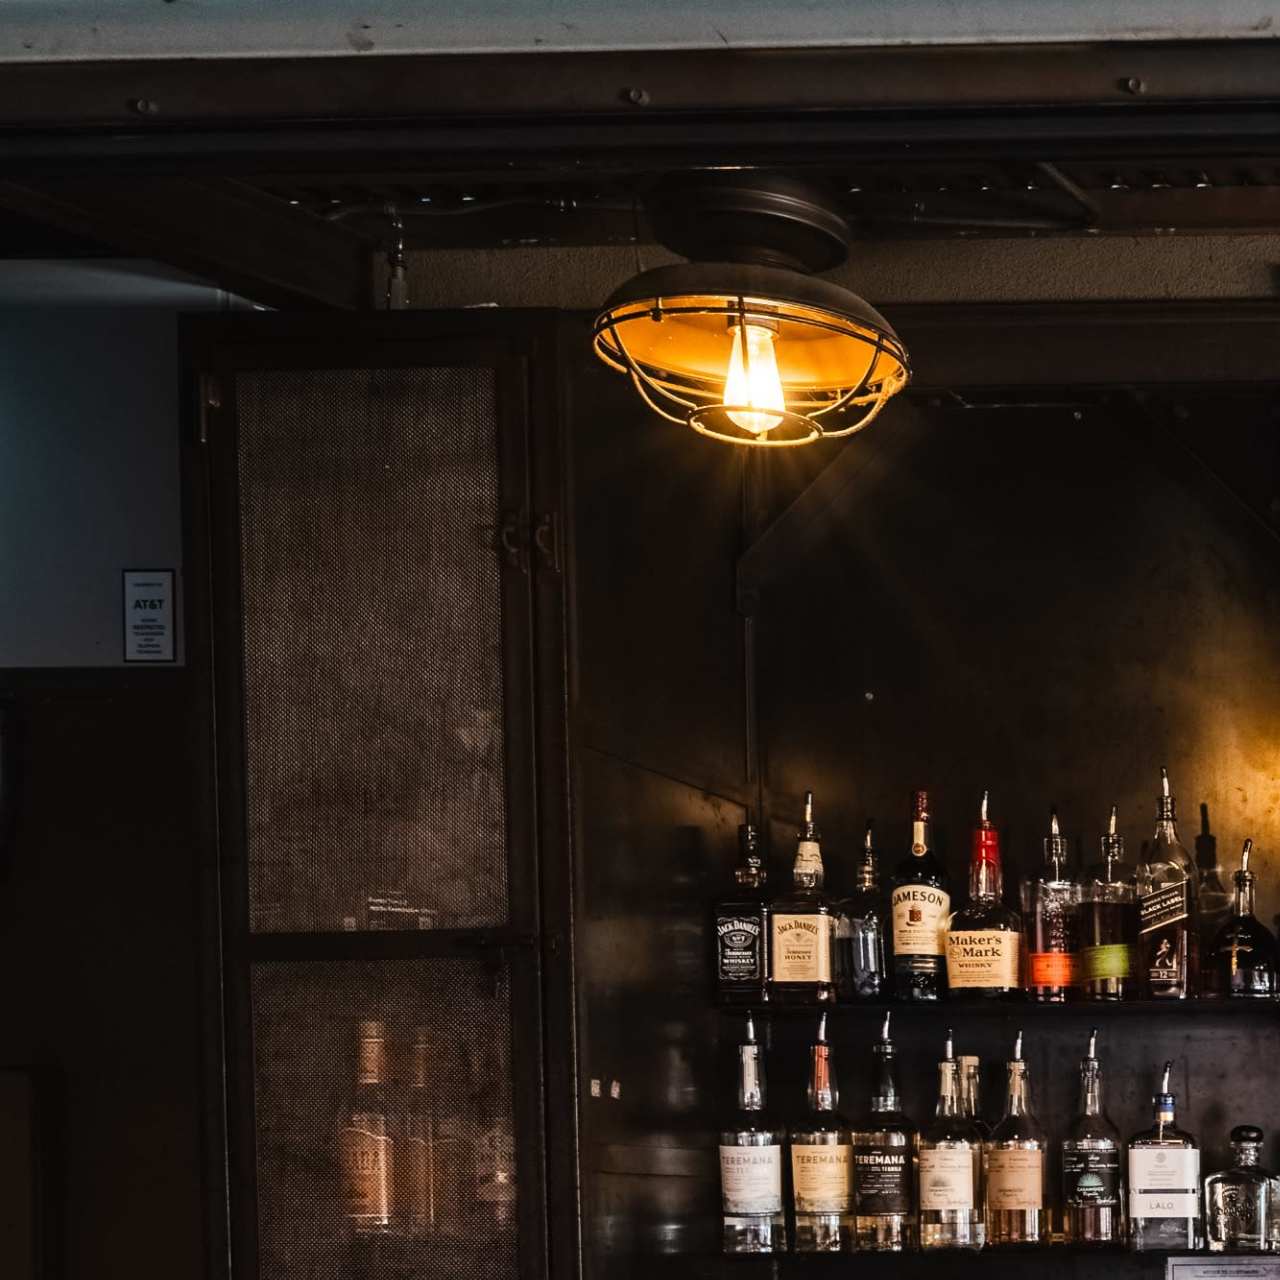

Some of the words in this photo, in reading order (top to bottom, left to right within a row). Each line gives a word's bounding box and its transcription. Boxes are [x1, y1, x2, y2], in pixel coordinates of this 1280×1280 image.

[134, 599, 163, 610] AT&T
[892, 890, 944, 907] JAMESON
[949, 935, 1002, 946] Maker's
[962, 947, 1001, 958] Mark
[722, 1156, 773, 1165] TEREMANA
[796, 1155, 848, 1165] TEREMANA
[855, 1155, 906, 1165] TEREMANA
[1150, 1201, 1174, 1210] LALO
